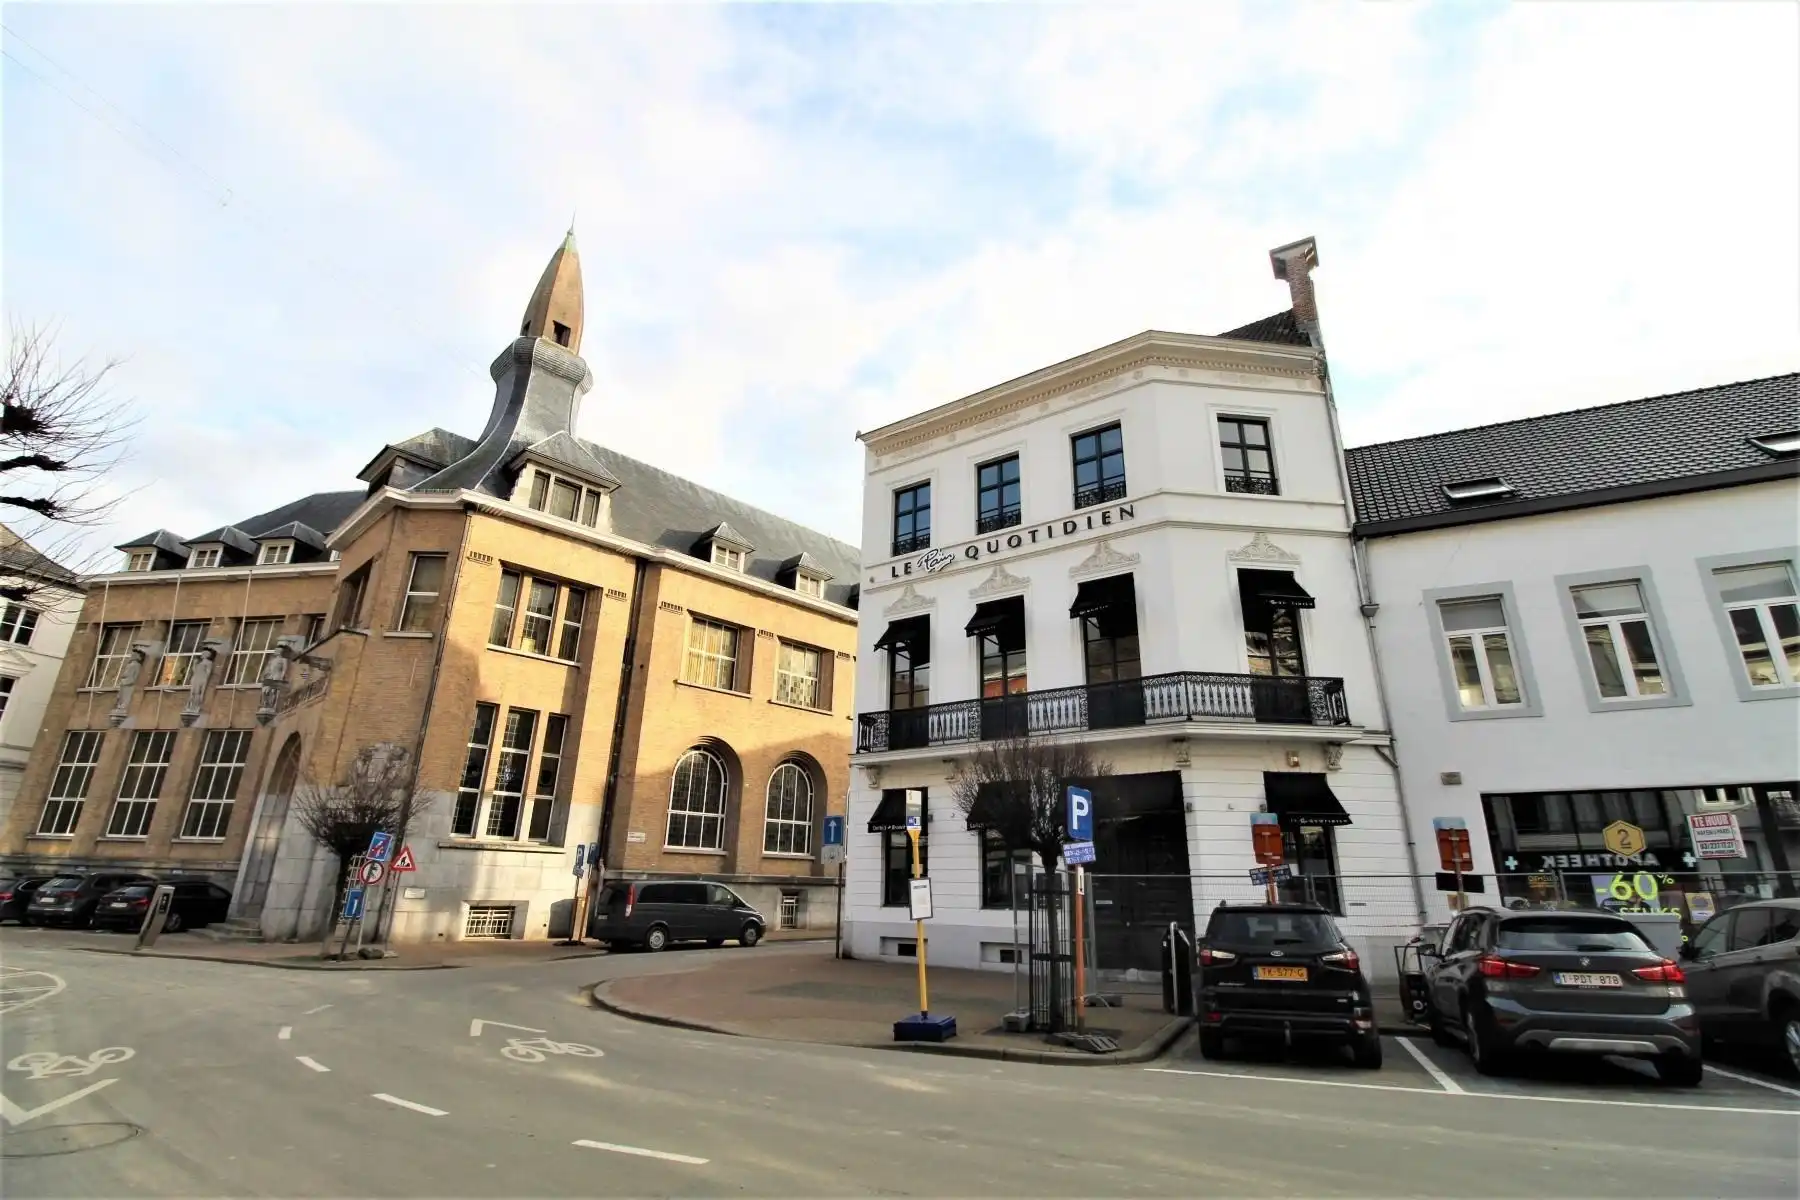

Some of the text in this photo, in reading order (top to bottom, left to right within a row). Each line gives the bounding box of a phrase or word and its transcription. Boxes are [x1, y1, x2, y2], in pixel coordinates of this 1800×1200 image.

[891, 562, 912, 578] LE
[964, 504, 1135, 561] QUOTIDIEN
[1071, 794, 1089, 830] P
[1693, 814, 1730, 828] TE HUUR
